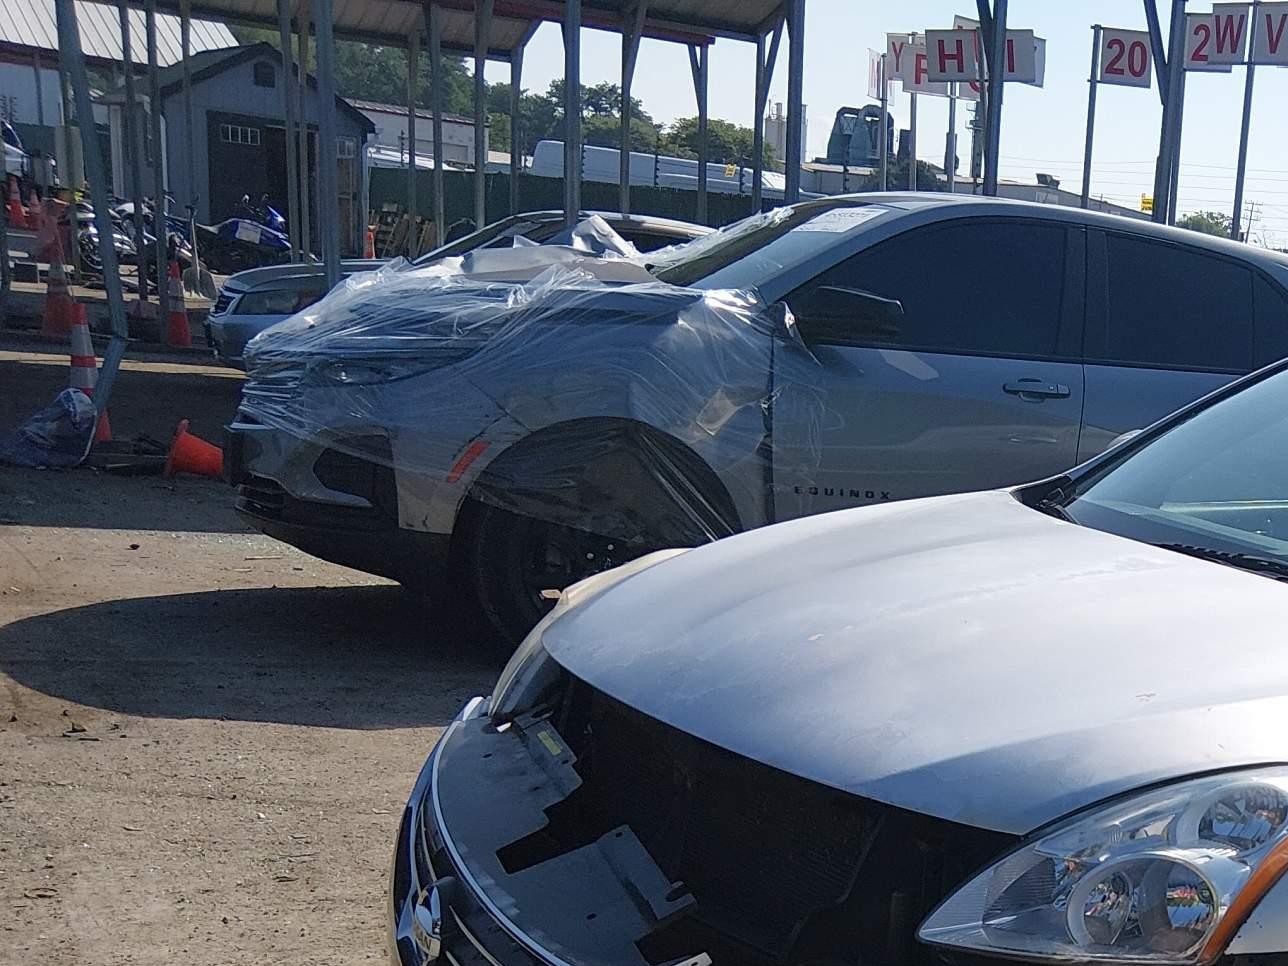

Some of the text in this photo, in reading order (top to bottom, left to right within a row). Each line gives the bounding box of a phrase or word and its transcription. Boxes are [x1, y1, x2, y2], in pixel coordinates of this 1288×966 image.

[1214, 14, 1245, 54] W
[1265, 13, 1288, 54] V
[937, 39, 964, 73] H
[1105, 38, 1148, 77] 20
[794, 485, 891, 500] EQUINOX
